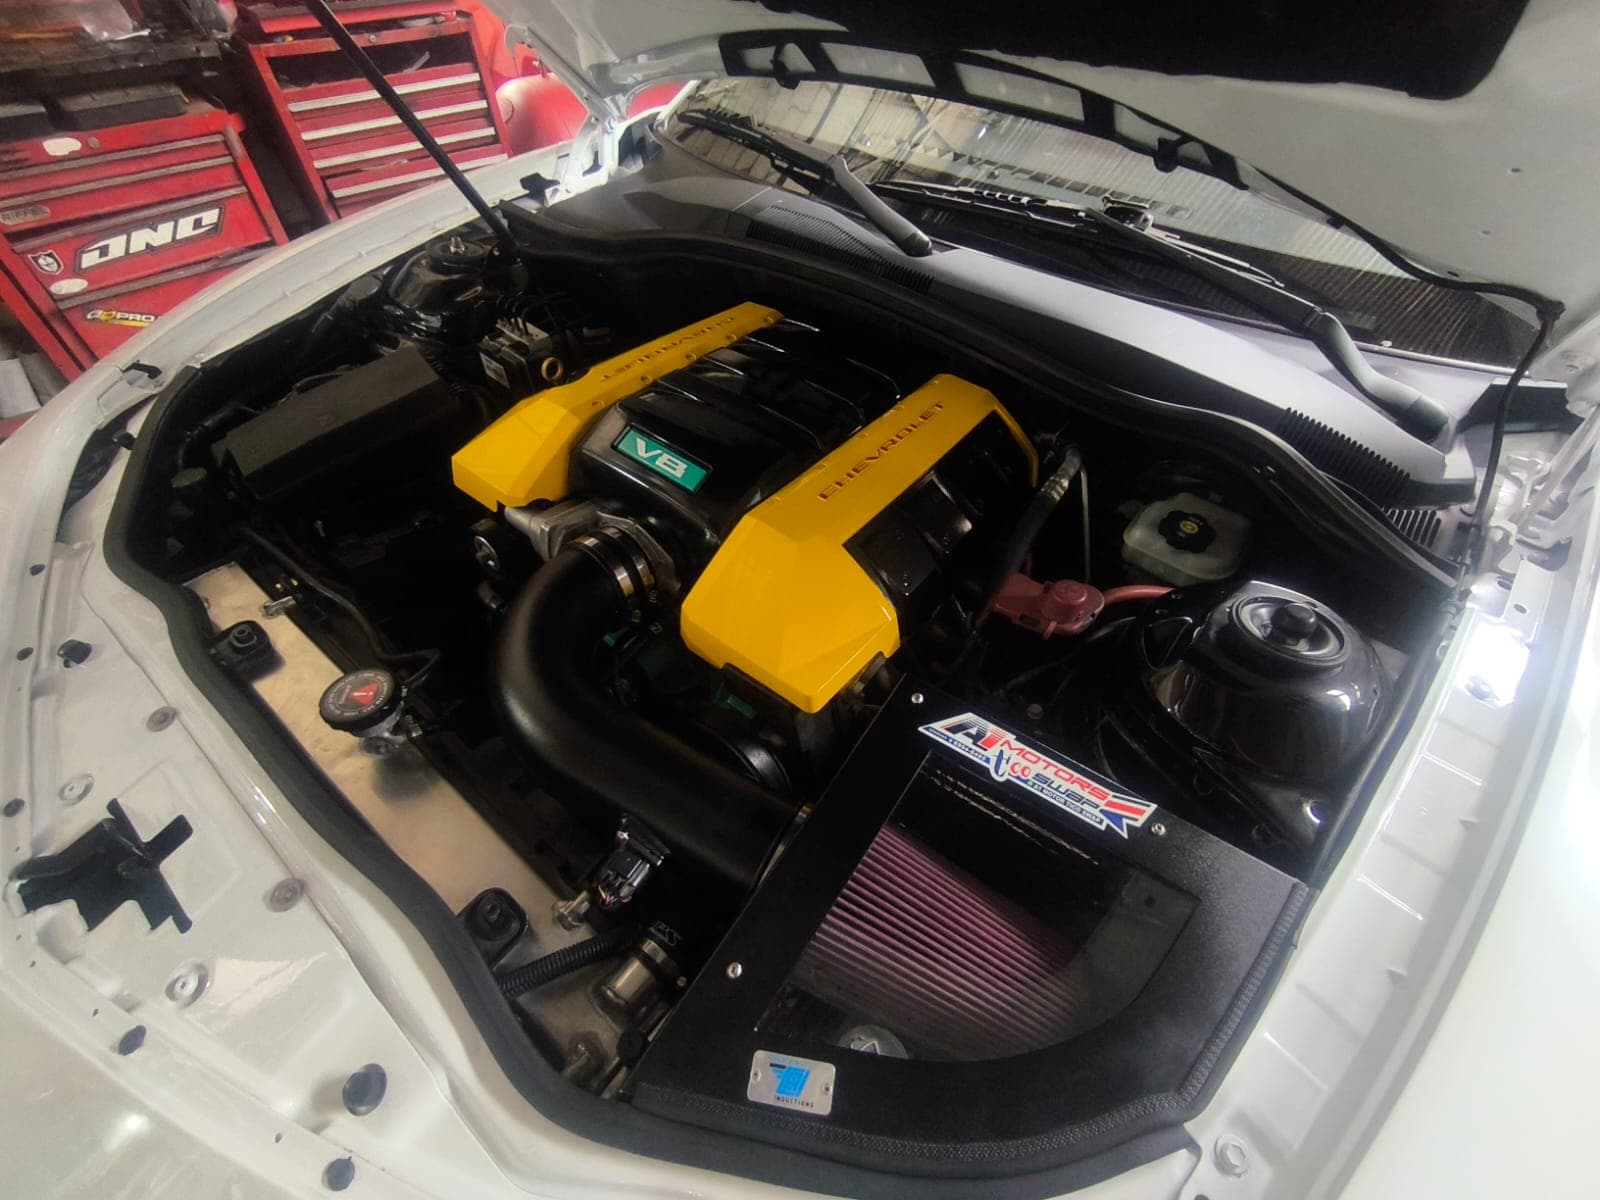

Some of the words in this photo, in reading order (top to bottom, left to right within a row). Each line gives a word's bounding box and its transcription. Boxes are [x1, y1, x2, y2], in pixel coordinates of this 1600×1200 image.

[636, 437, 689, 480] V8
[817, 402, 944, 501] CHEVROLET
[1000, 739, 1112, 801] MOTORS
